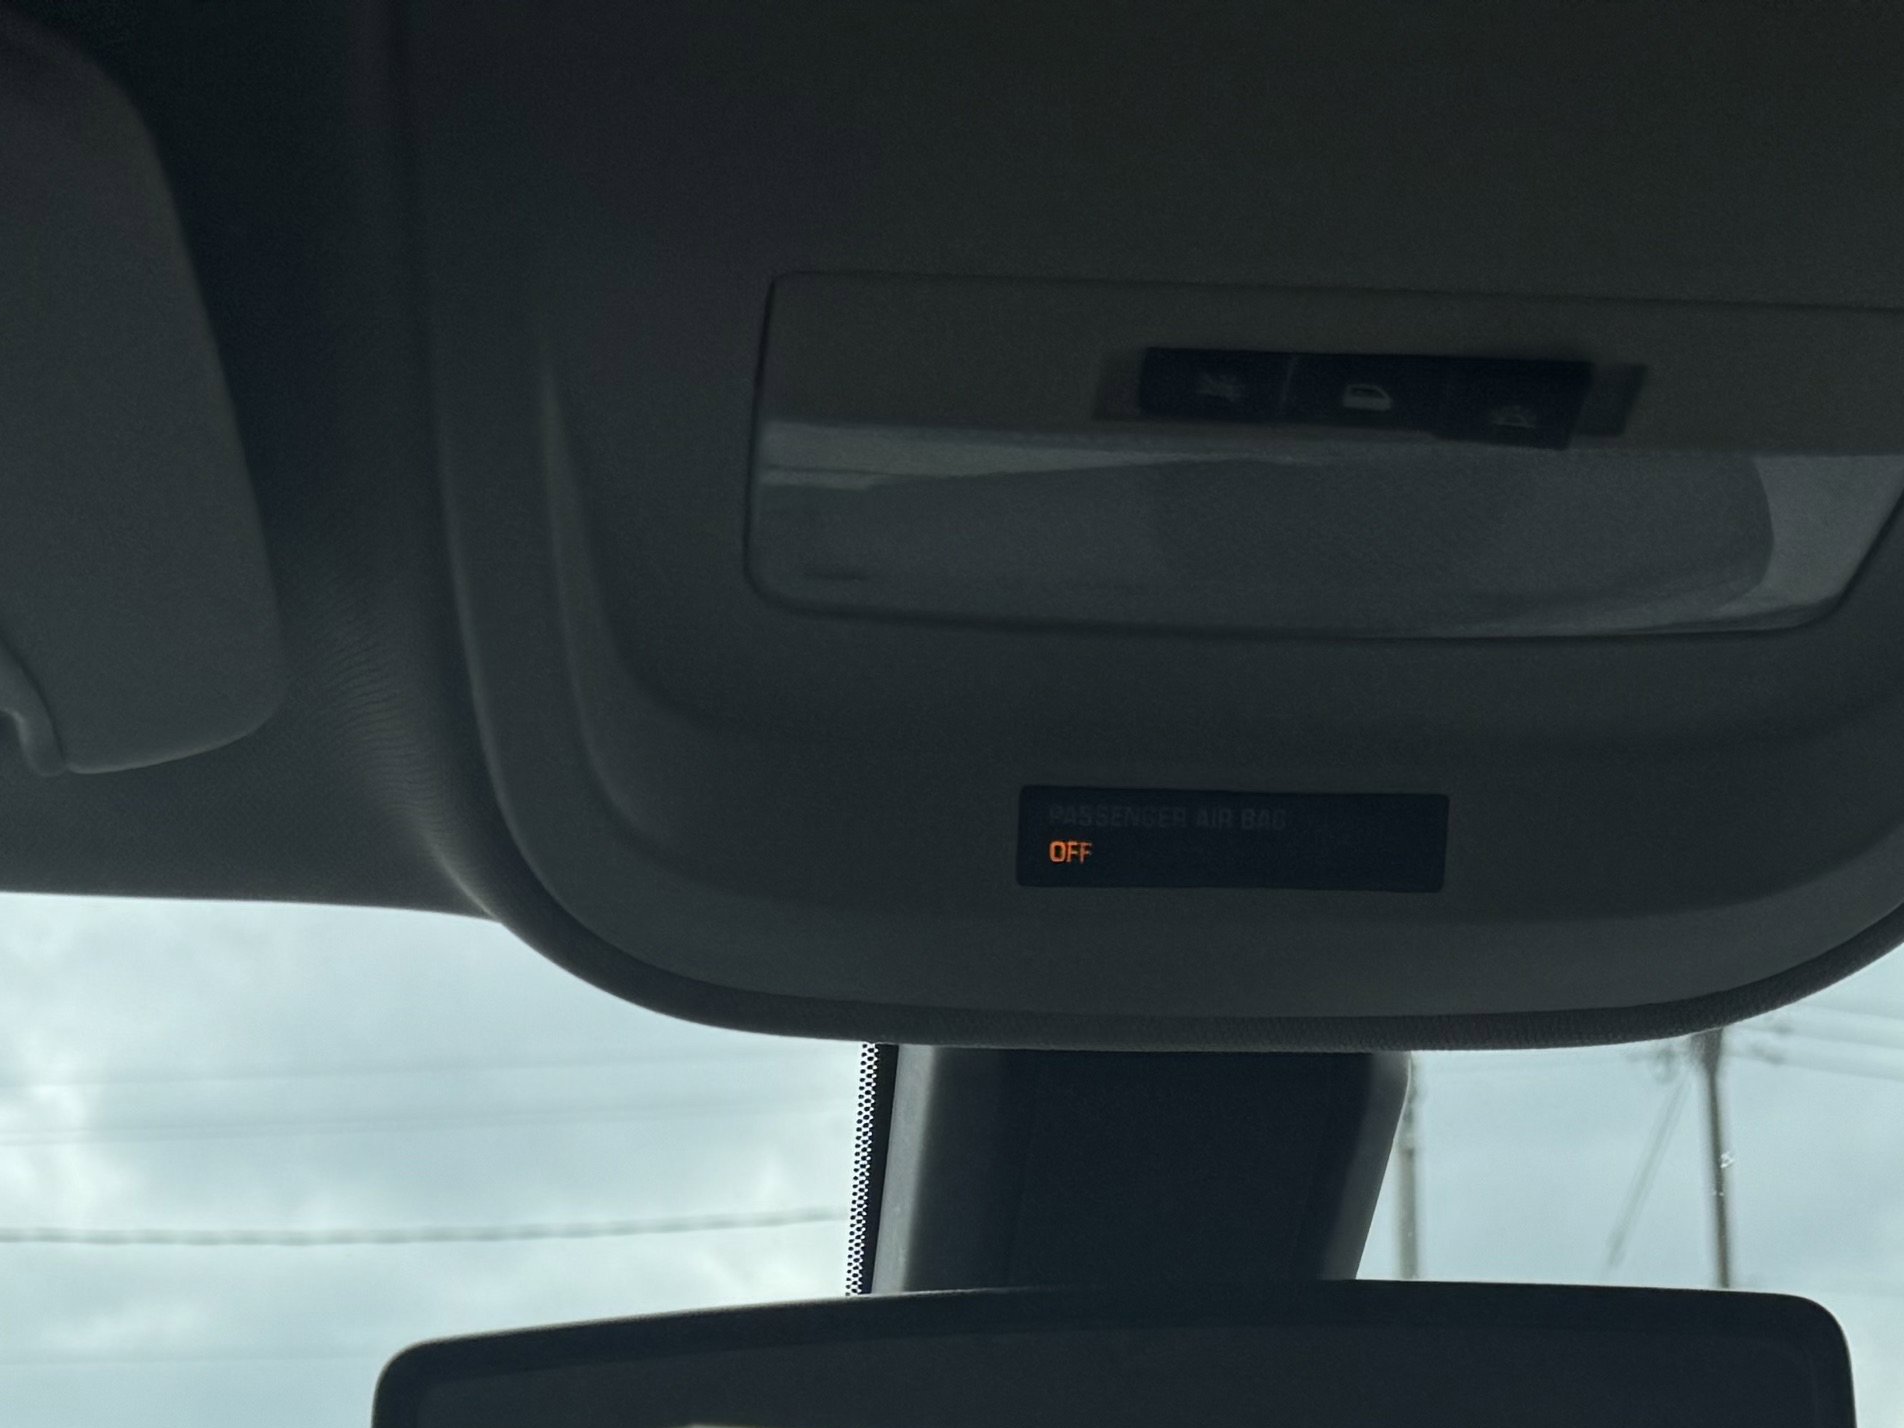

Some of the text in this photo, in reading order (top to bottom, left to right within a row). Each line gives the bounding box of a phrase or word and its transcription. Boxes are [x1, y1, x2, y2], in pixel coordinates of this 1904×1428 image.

[1049, 805, 1287, 830] PASSENGER AIR BAG
[1049, 840, 1093, 863] OFF
